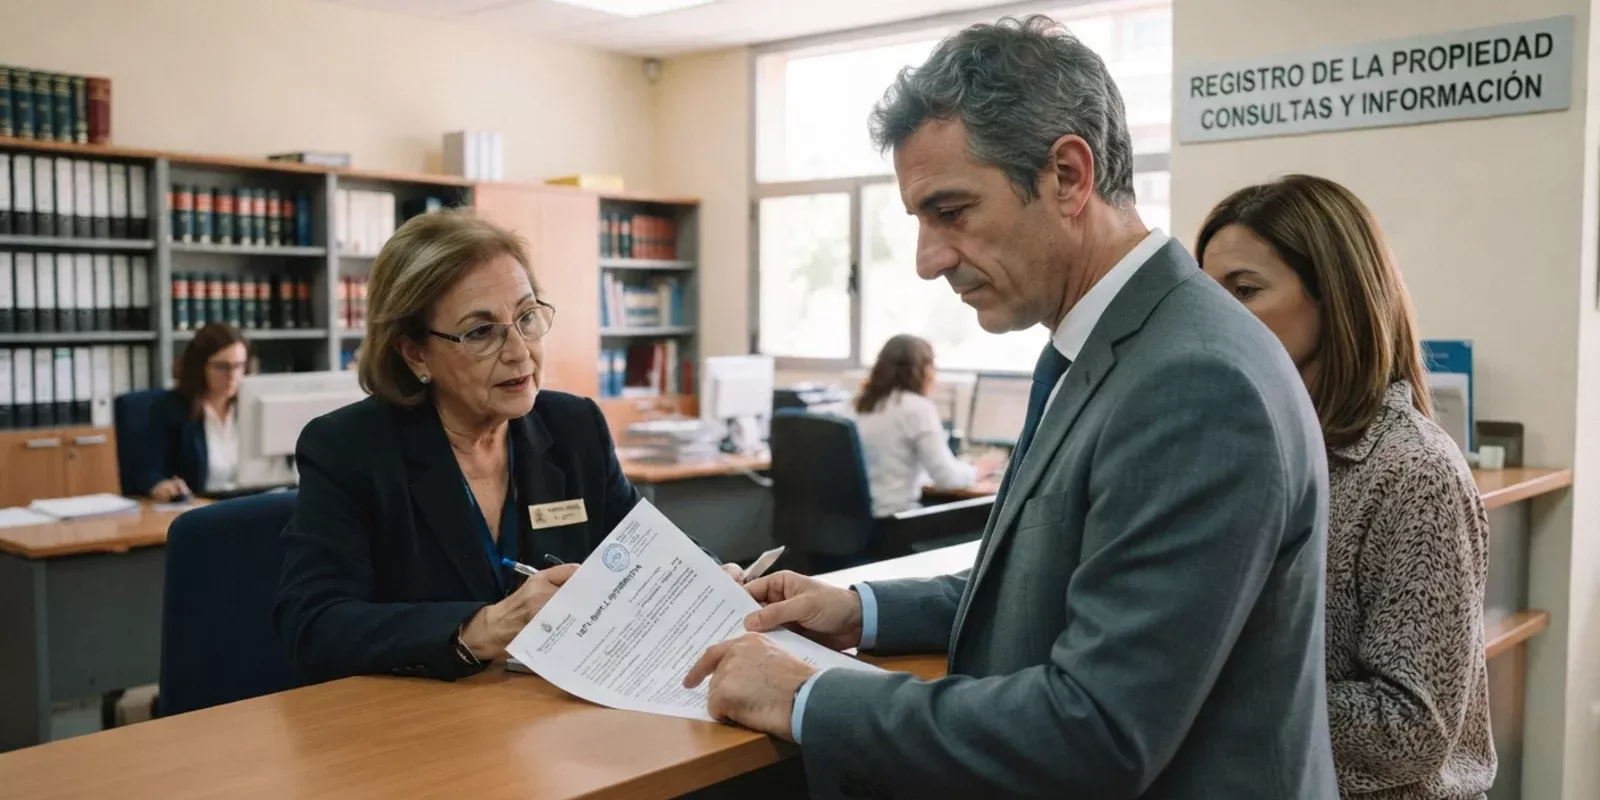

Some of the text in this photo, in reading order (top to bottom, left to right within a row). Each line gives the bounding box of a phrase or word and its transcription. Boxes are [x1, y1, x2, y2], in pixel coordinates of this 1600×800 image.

[1190, 32, 1554, 98] REGISTRO DE LA PROPIEDAD
[1200, 71, 1543, 130] CONSULTAS Y INFORMACIÓN
